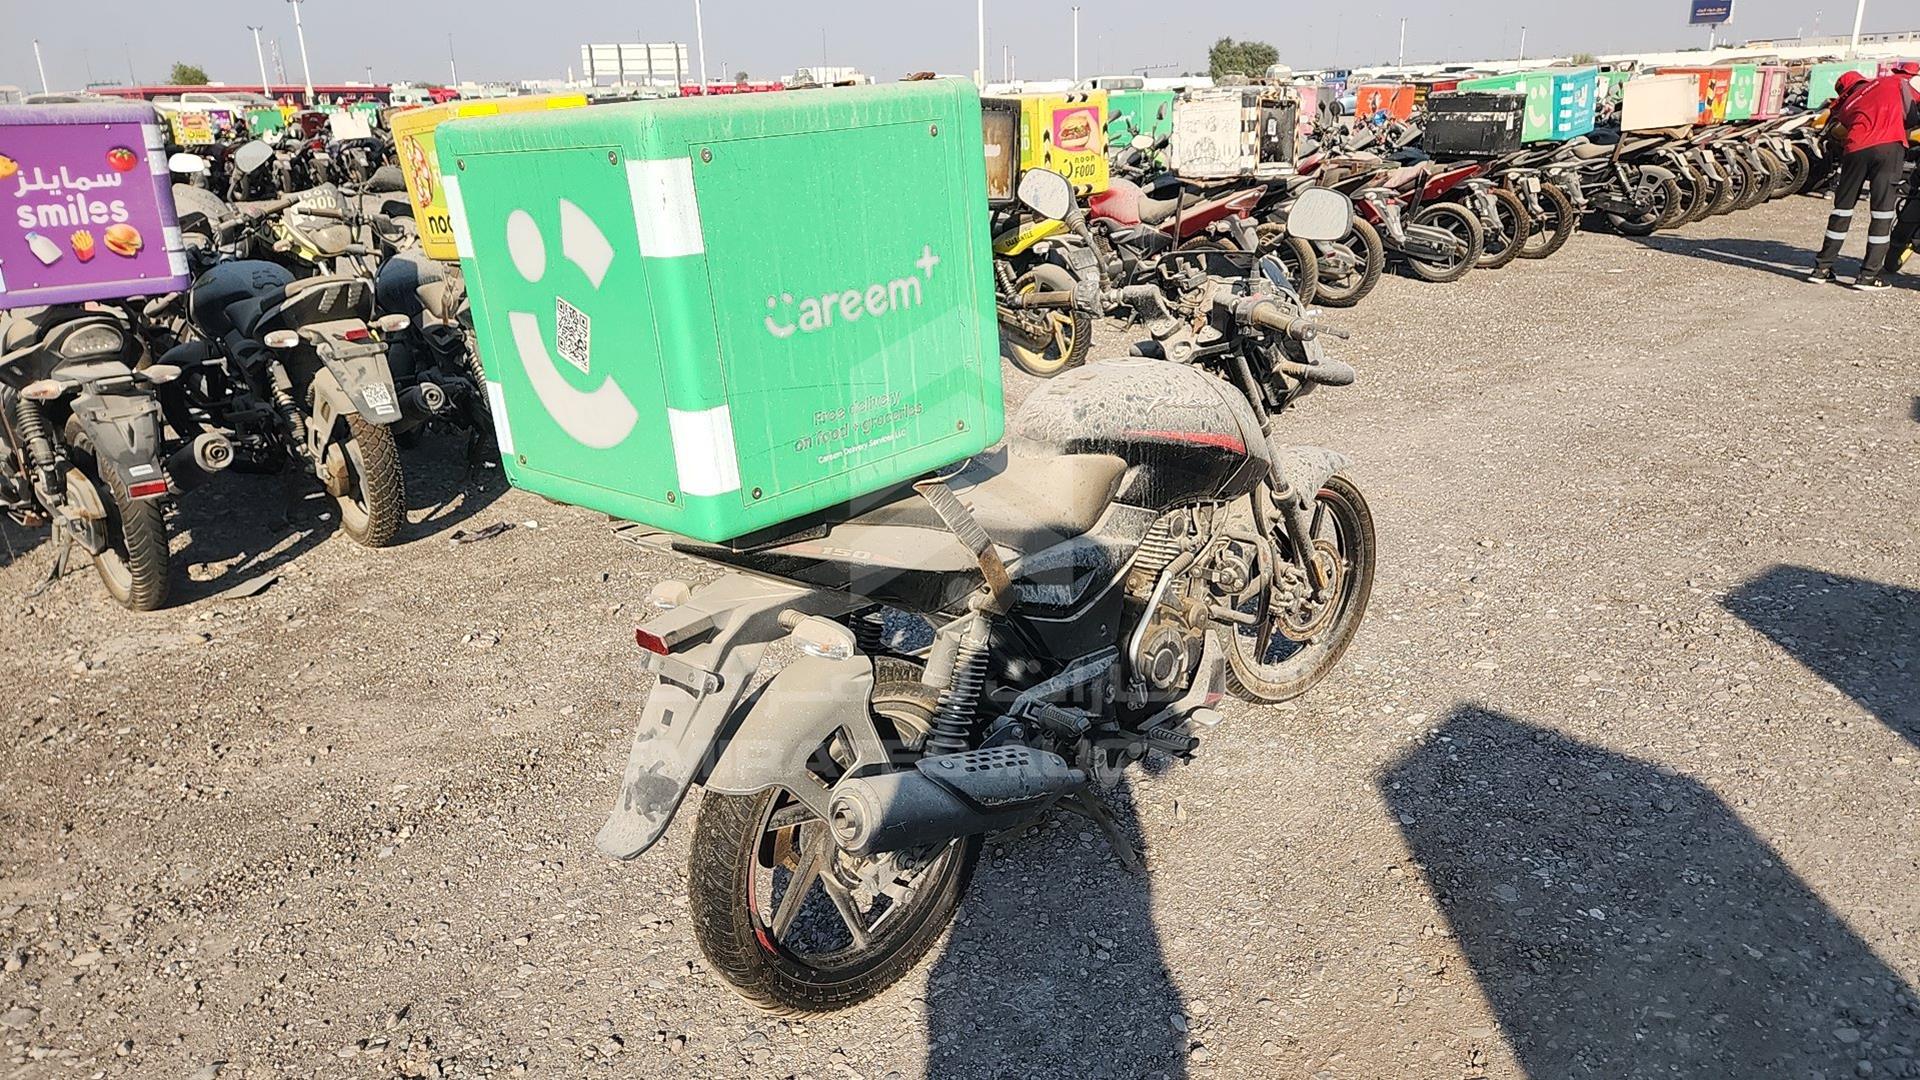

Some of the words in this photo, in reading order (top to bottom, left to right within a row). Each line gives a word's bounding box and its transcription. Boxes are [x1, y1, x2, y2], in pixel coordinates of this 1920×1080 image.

[14, 166, 122, 198] سمايلز
[1074, 163, 1096, 178] FOOD
[16, 192, 129, 229] smiles
[813, 407, 846, 426] Free
[848, 390, 902, 415] delivery
[793, 436, 813, 453] on
[815, 422, 850, 446] food
[862, 402, 923, 434] groceries
[843, 442, 868, 455] Delivery
[821, 546, 872, 560] 150
